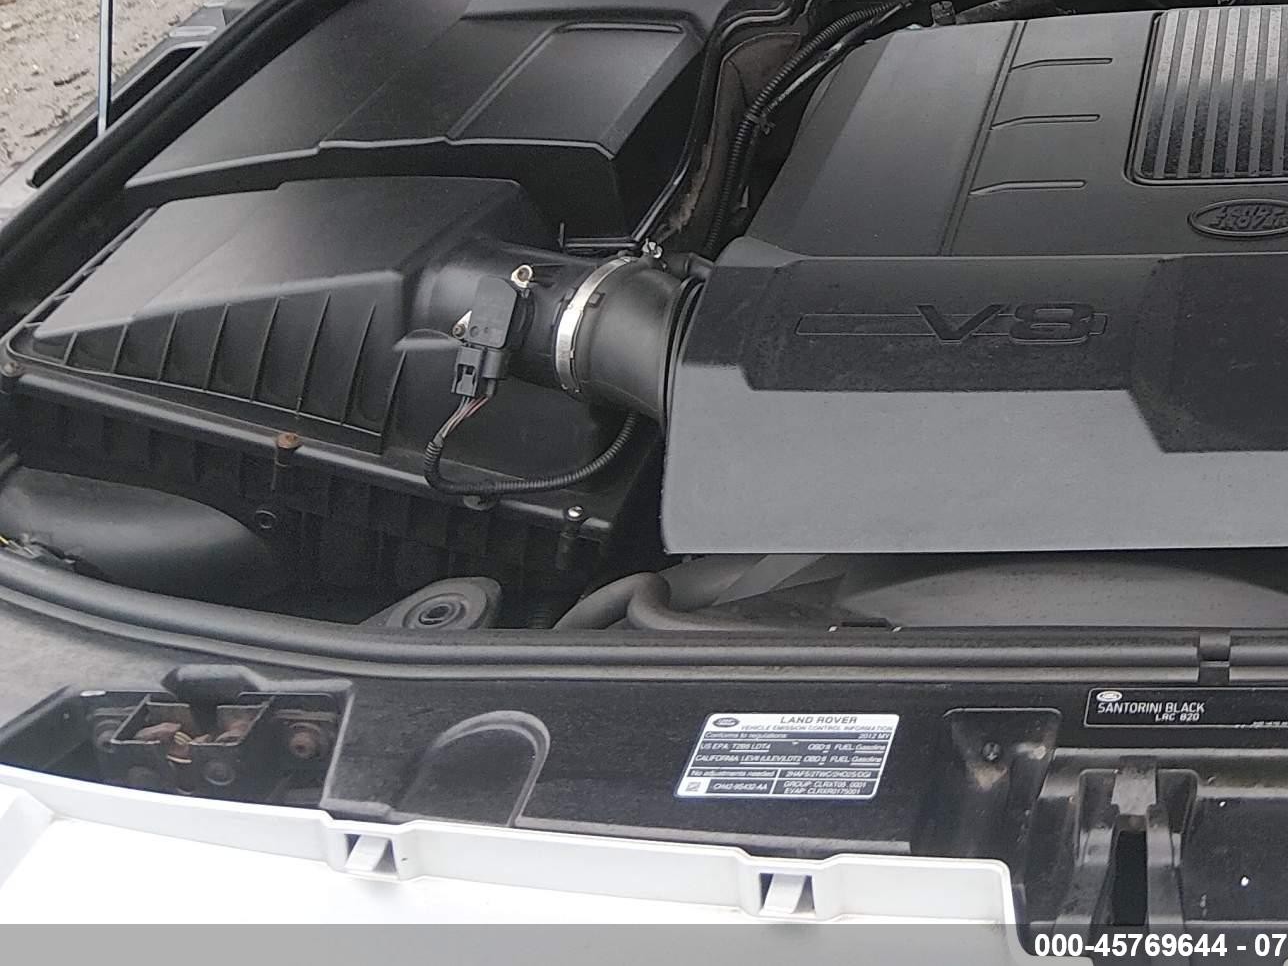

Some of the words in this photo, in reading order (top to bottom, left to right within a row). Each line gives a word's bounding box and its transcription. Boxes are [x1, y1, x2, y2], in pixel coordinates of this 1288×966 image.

[914, 301, 1094, 345] V8
[1097, 702, 1162, 714] SANTORINI
[1165, 702, 1205, 714] BLACK
[780, 716, 814, 724] LAND
[816, 716, 858, 724] ROVER
[1155, 713, 1175, 722] LRC
[1179, 713, 1200, 722] 820
